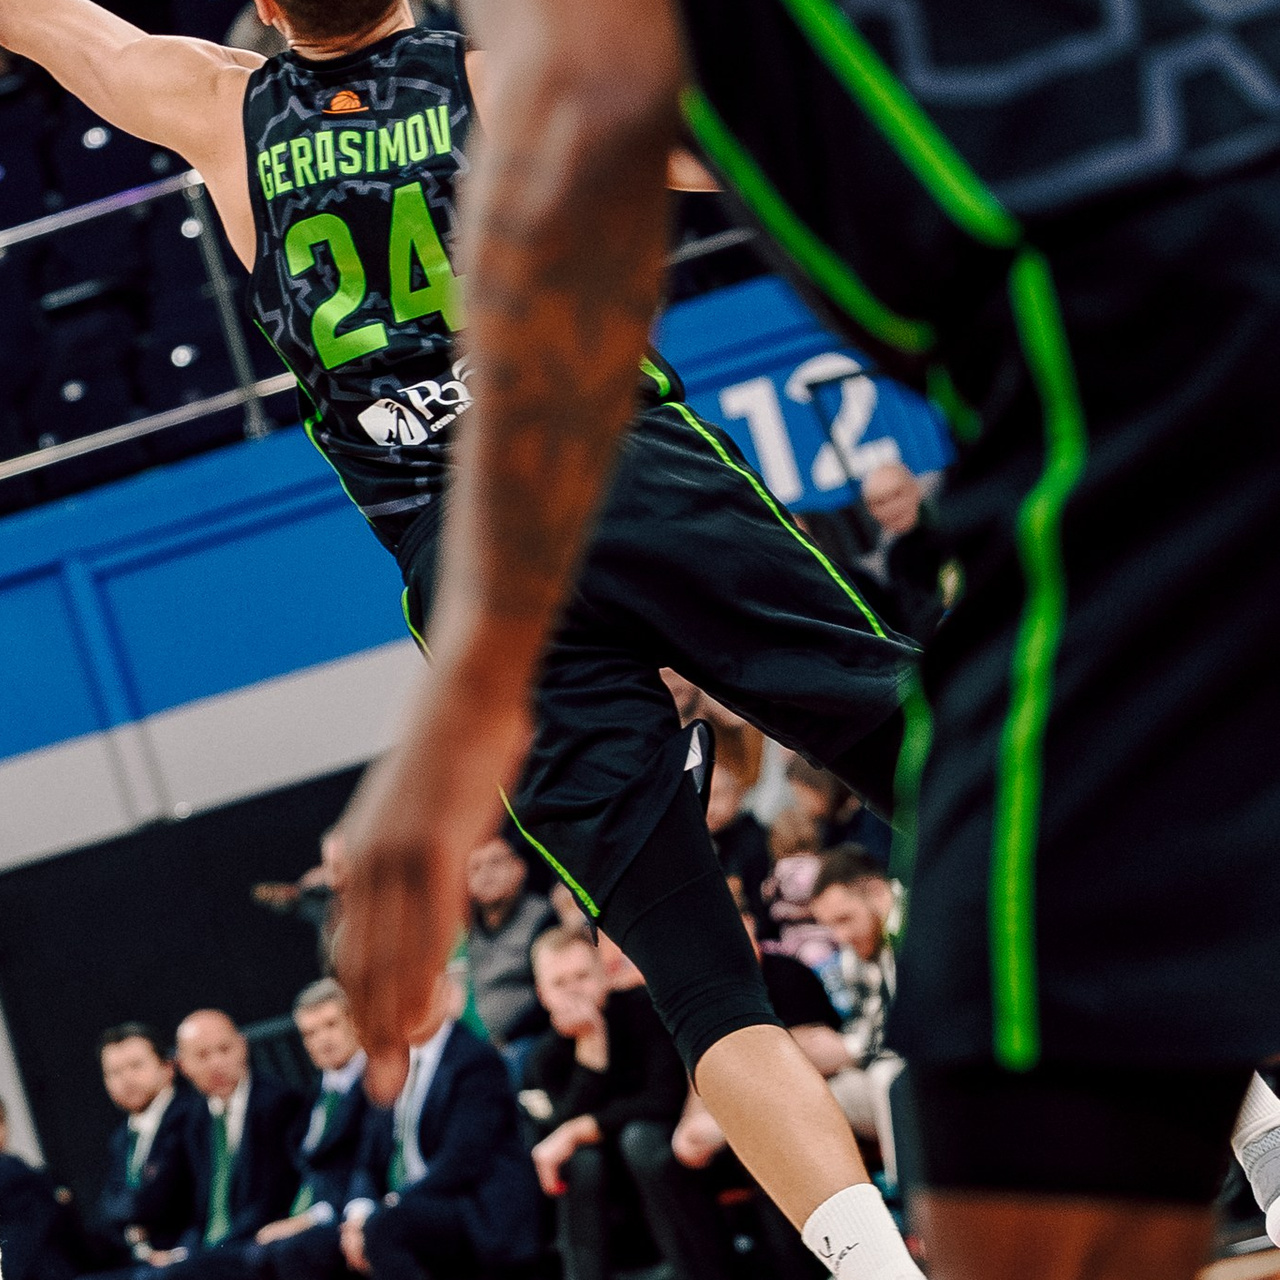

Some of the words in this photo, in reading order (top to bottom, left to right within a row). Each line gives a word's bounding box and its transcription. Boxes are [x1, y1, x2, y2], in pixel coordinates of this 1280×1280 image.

[257, 104, 452, 201] GERASIMOV
[284, 181, 470, 370] 24
[717, 352, 903, 507] 12
